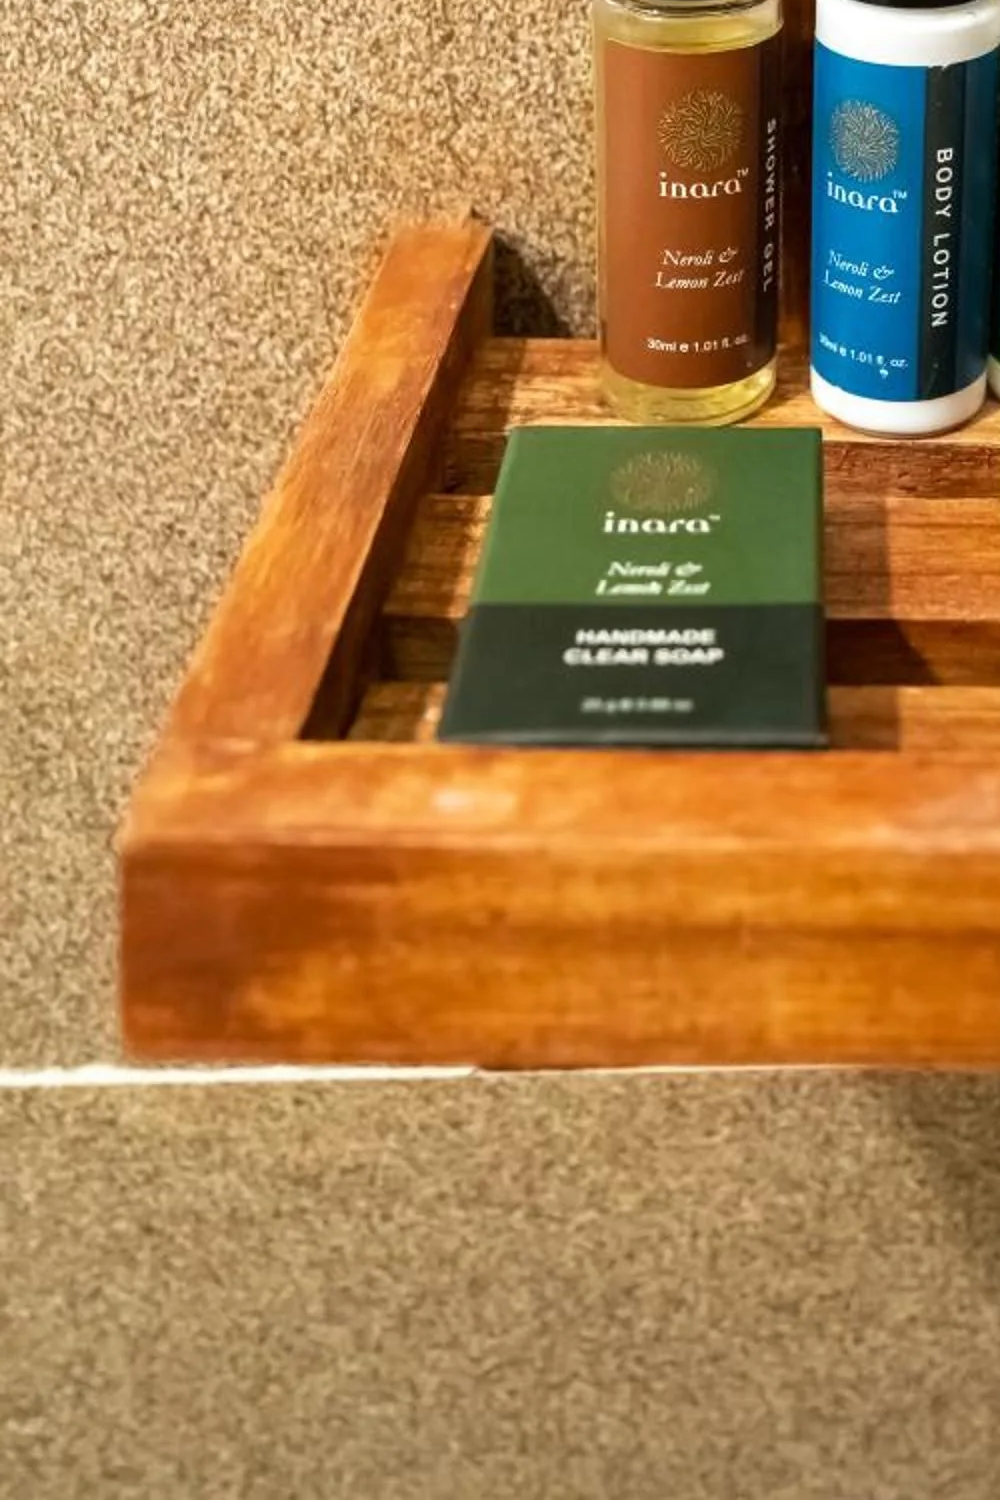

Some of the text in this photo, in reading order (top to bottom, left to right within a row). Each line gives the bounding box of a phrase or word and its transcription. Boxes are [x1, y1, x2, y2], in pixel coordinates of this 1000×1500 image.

[763, 117, 778, 293] SHOWER GEL
[931, 147, 953, 328] BODY LOTION
[663, 247, 738, 266] Neroli &
[828, 249, 895, 281] Neroli &
[655, 269, 744, 289] Lemon Zest
[822, 269, 901, 304] Lemon Zest
[575, 628, 717, 646] HANDMADE
[562, 647, 725, 666] CLEAR SOAP
